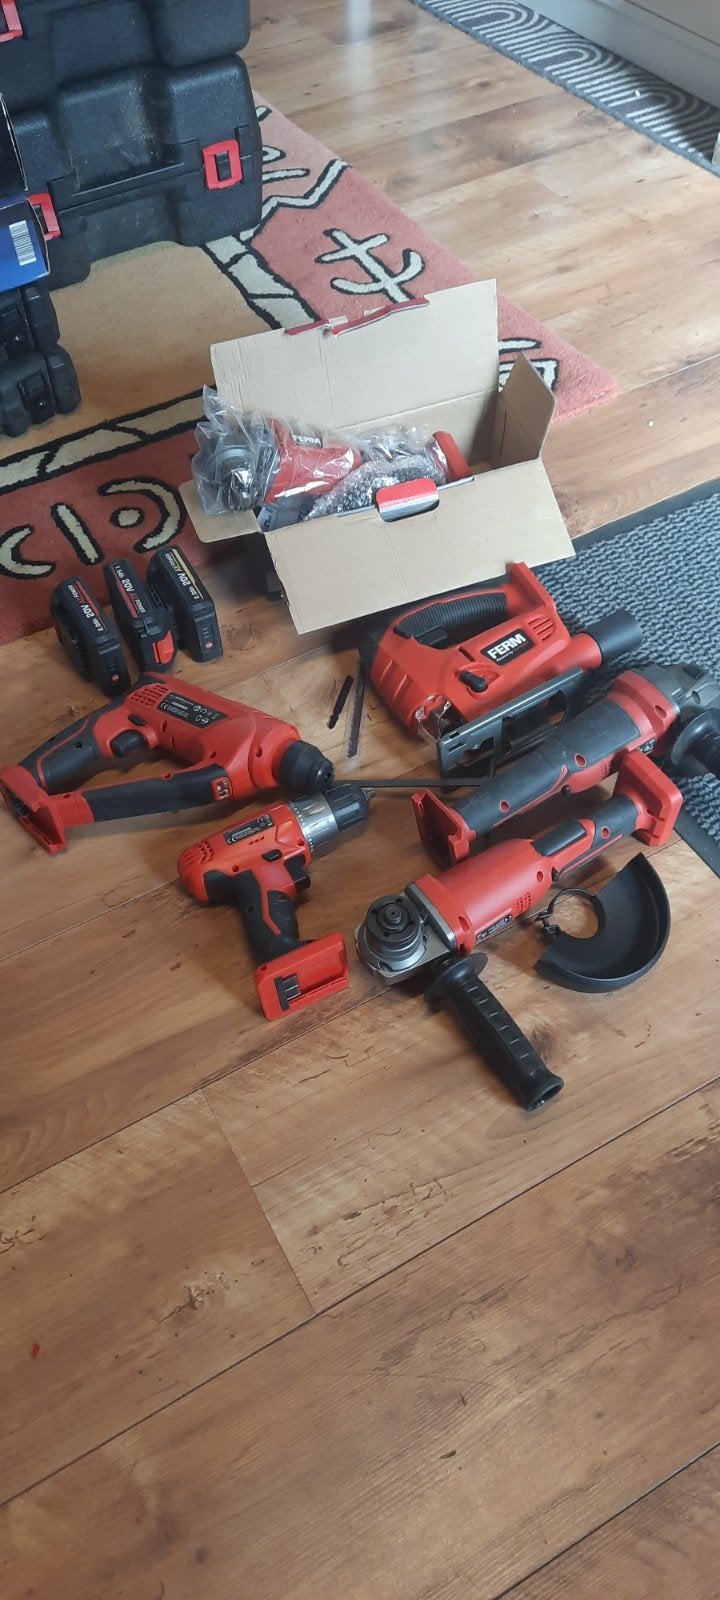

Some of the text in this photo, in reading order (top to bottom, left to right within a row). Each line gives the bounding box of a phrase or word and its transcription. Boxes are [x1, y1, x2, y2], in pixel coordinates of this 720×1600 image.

[121, 578, 135, 592] 20V
[177, 572, 191, 586] 20V
[81, 604, 95, 618] 20V
[486, 633, 527, 660] FERM
